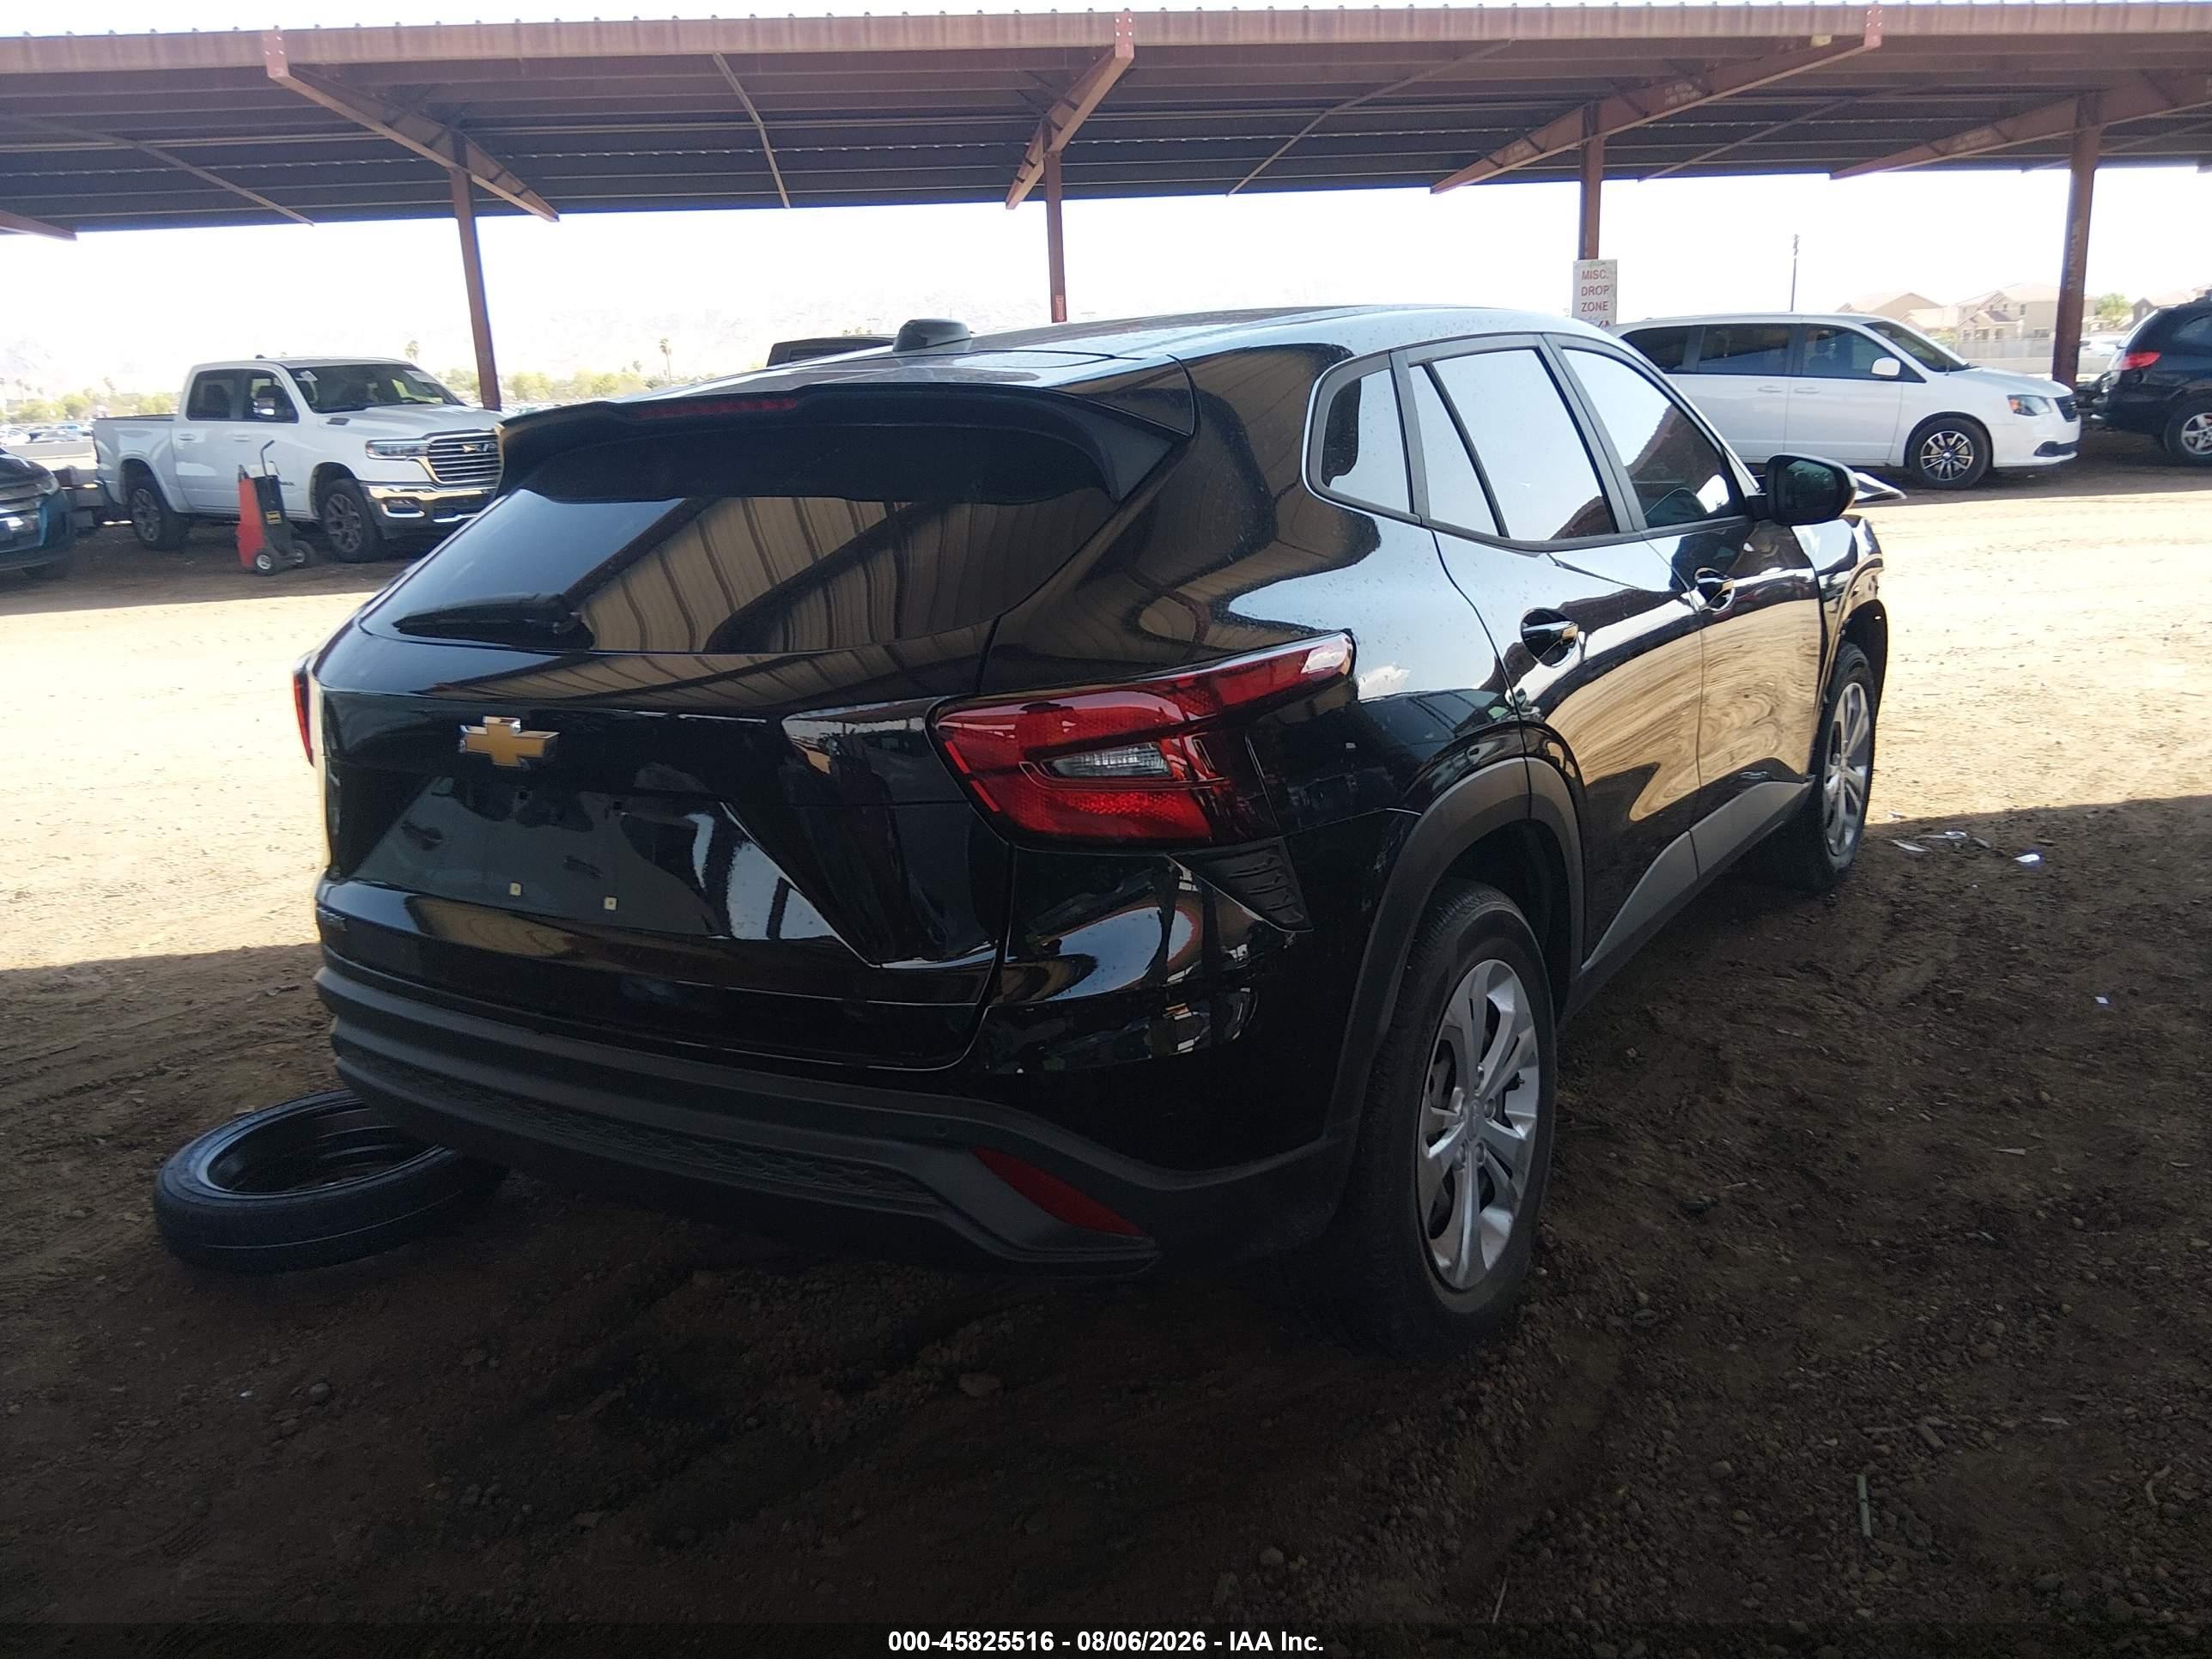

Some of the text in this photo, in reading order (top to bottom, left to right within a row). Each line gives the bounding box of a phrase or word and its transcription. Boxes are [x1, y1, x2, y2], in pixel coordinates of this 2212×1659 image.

[1581, 269, 1609, 280] MISC.
[1581, 285, 1609, 296] DROP
[1581, 301, 1609, 313] ZONE
